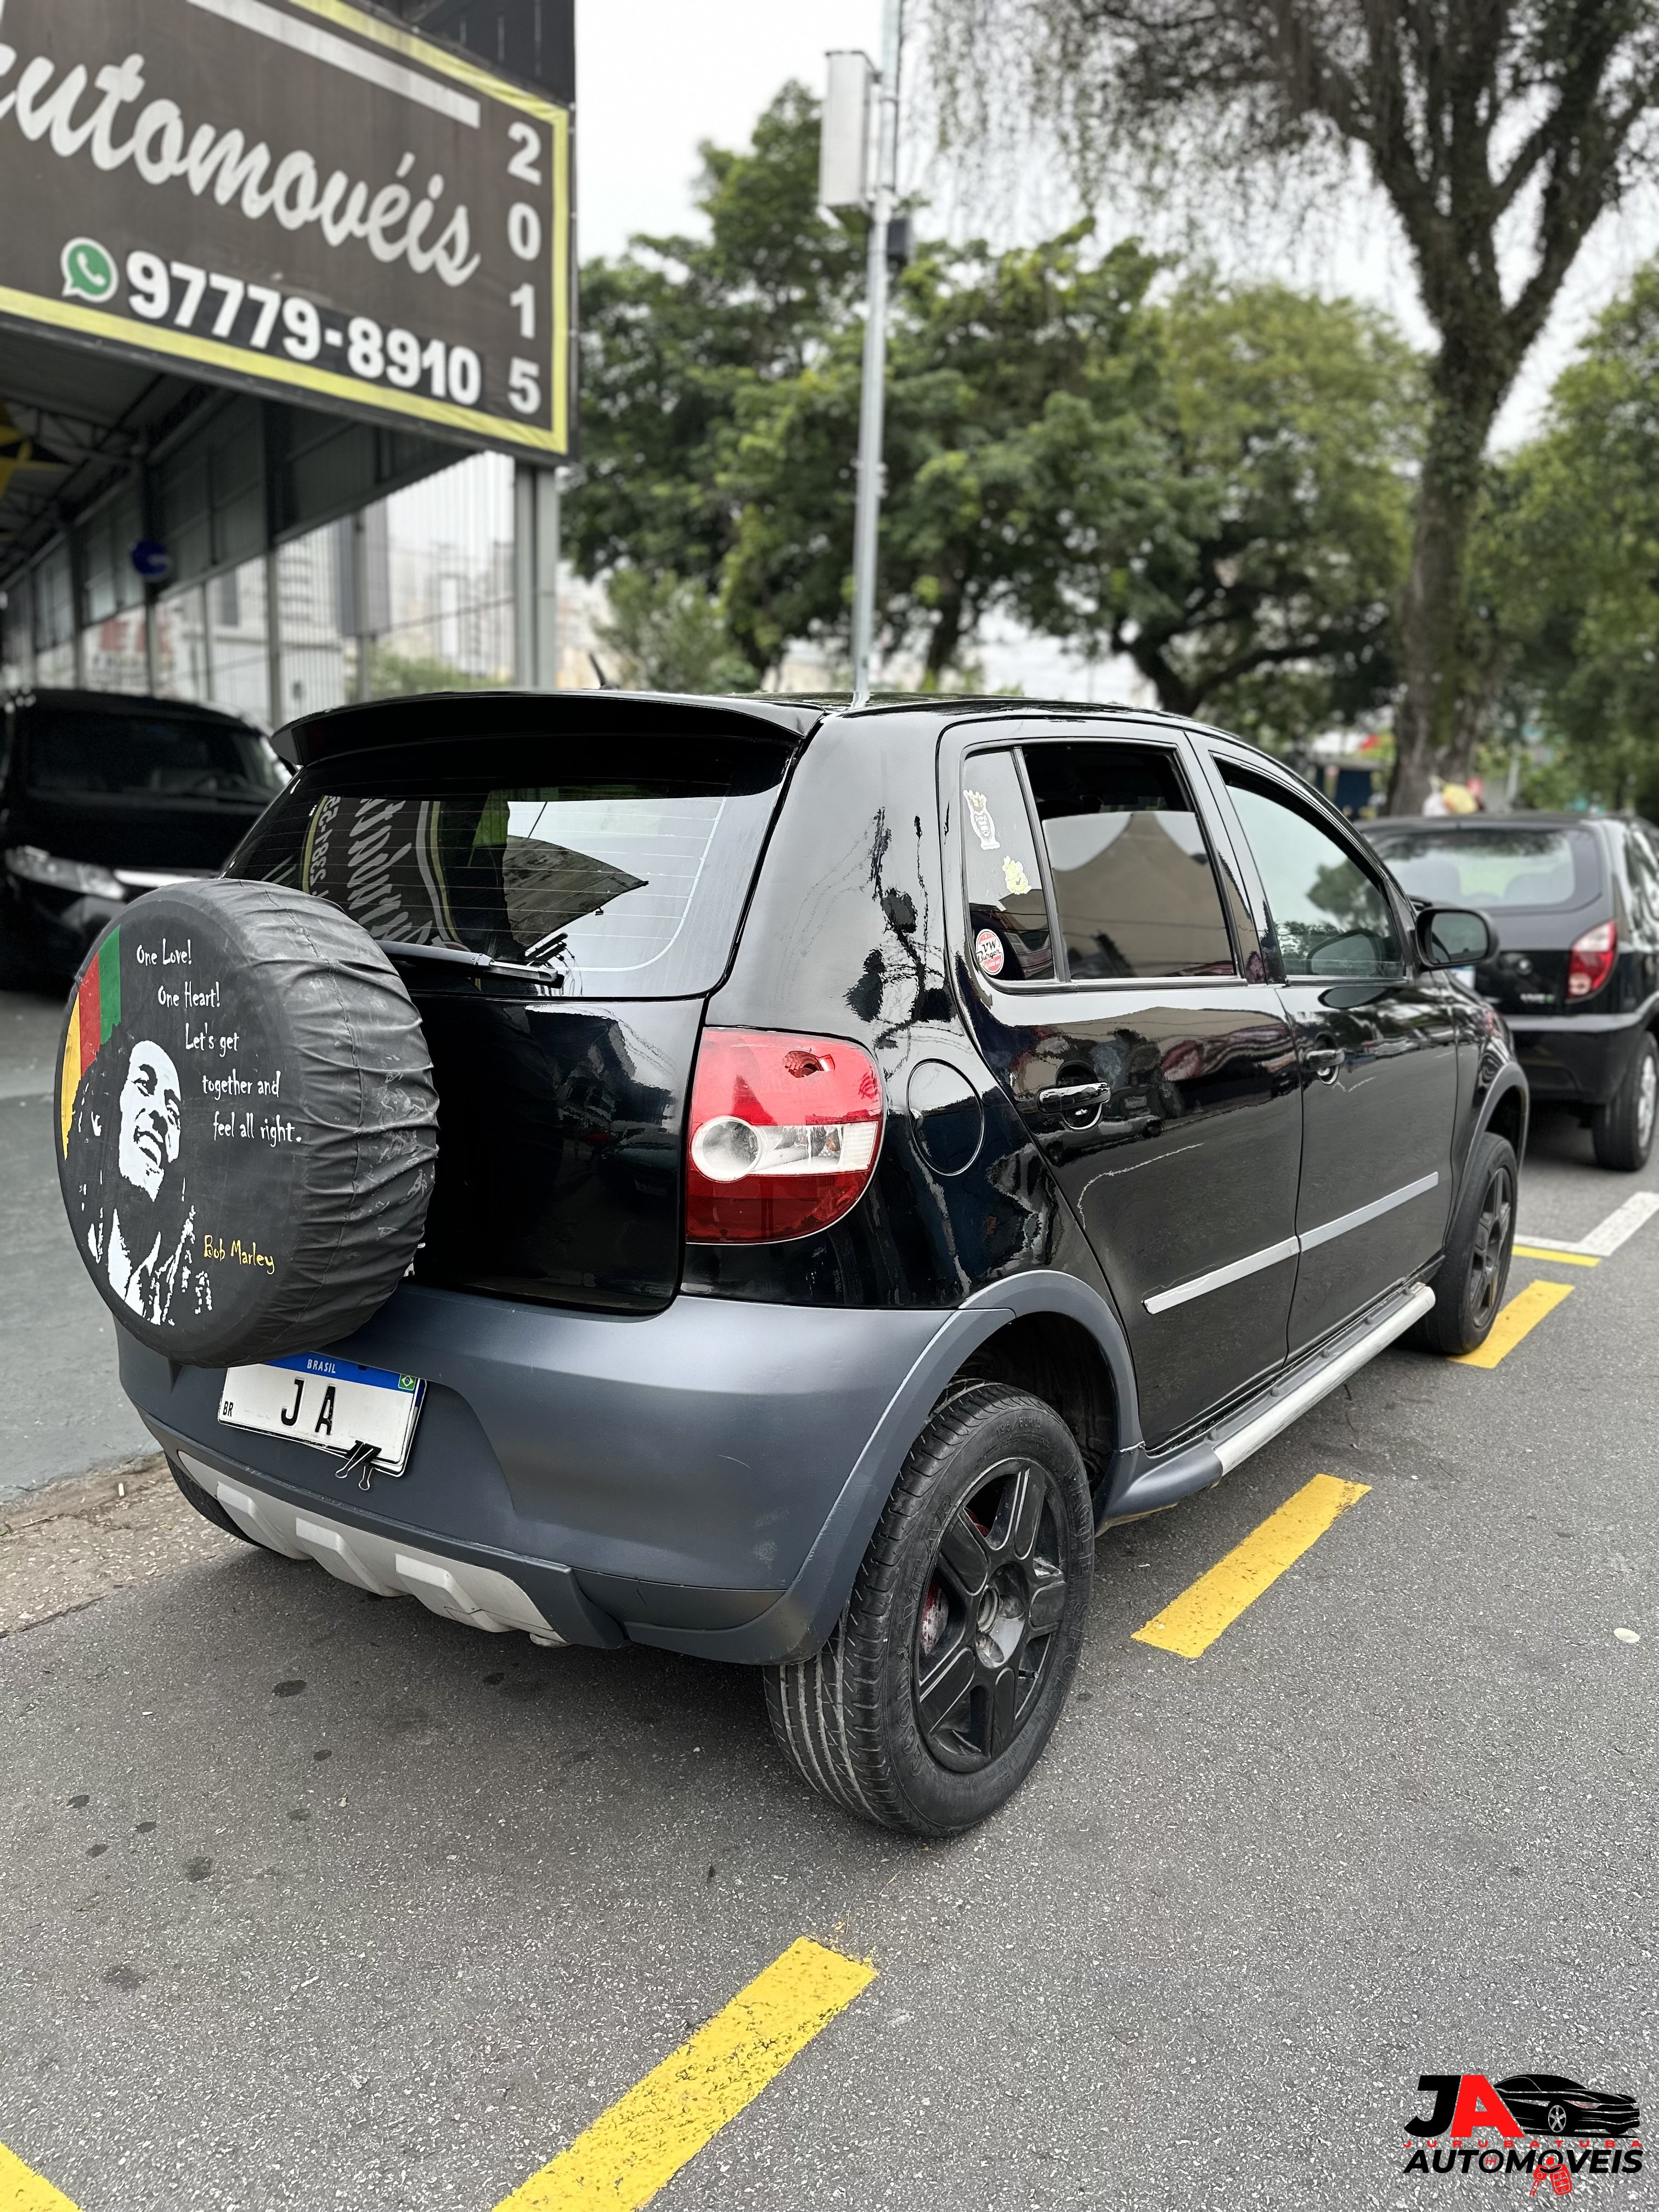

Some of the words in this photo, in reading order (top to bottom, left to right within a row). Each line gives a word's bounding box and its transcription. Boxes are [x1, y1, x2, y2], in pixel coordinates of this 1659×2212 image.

[0, 43, 481, 286] utomovéis
[126, 251, 481, 405] 97779-8910
[137, 944, 157, 966] One
[162, 938, 193, 966] Love!
[976, 950, 1002, 963] Burger
[982, 939, 996, 953] VW
[158, 985, 179, 1008] One
[184, 981, 221, 1008] Heart!
[185, 1022, 215, 1051] Let's
[219, 1032, 240, 1057] get
[202, 1068, 253, 1101] together
[257, 1070, 281, 1098] and
[213, 1111, 235, 1141] feel
[240, 1112, 255, 1139] all
[260, 1114, 302, 1148] right.
[204, 1234, 225, 1262] Bob
[230, 1239, 275, 1275] Marley
[307, 1358, 336, 1374] BRASIL
[223, 1401, 234, 1417] BR
